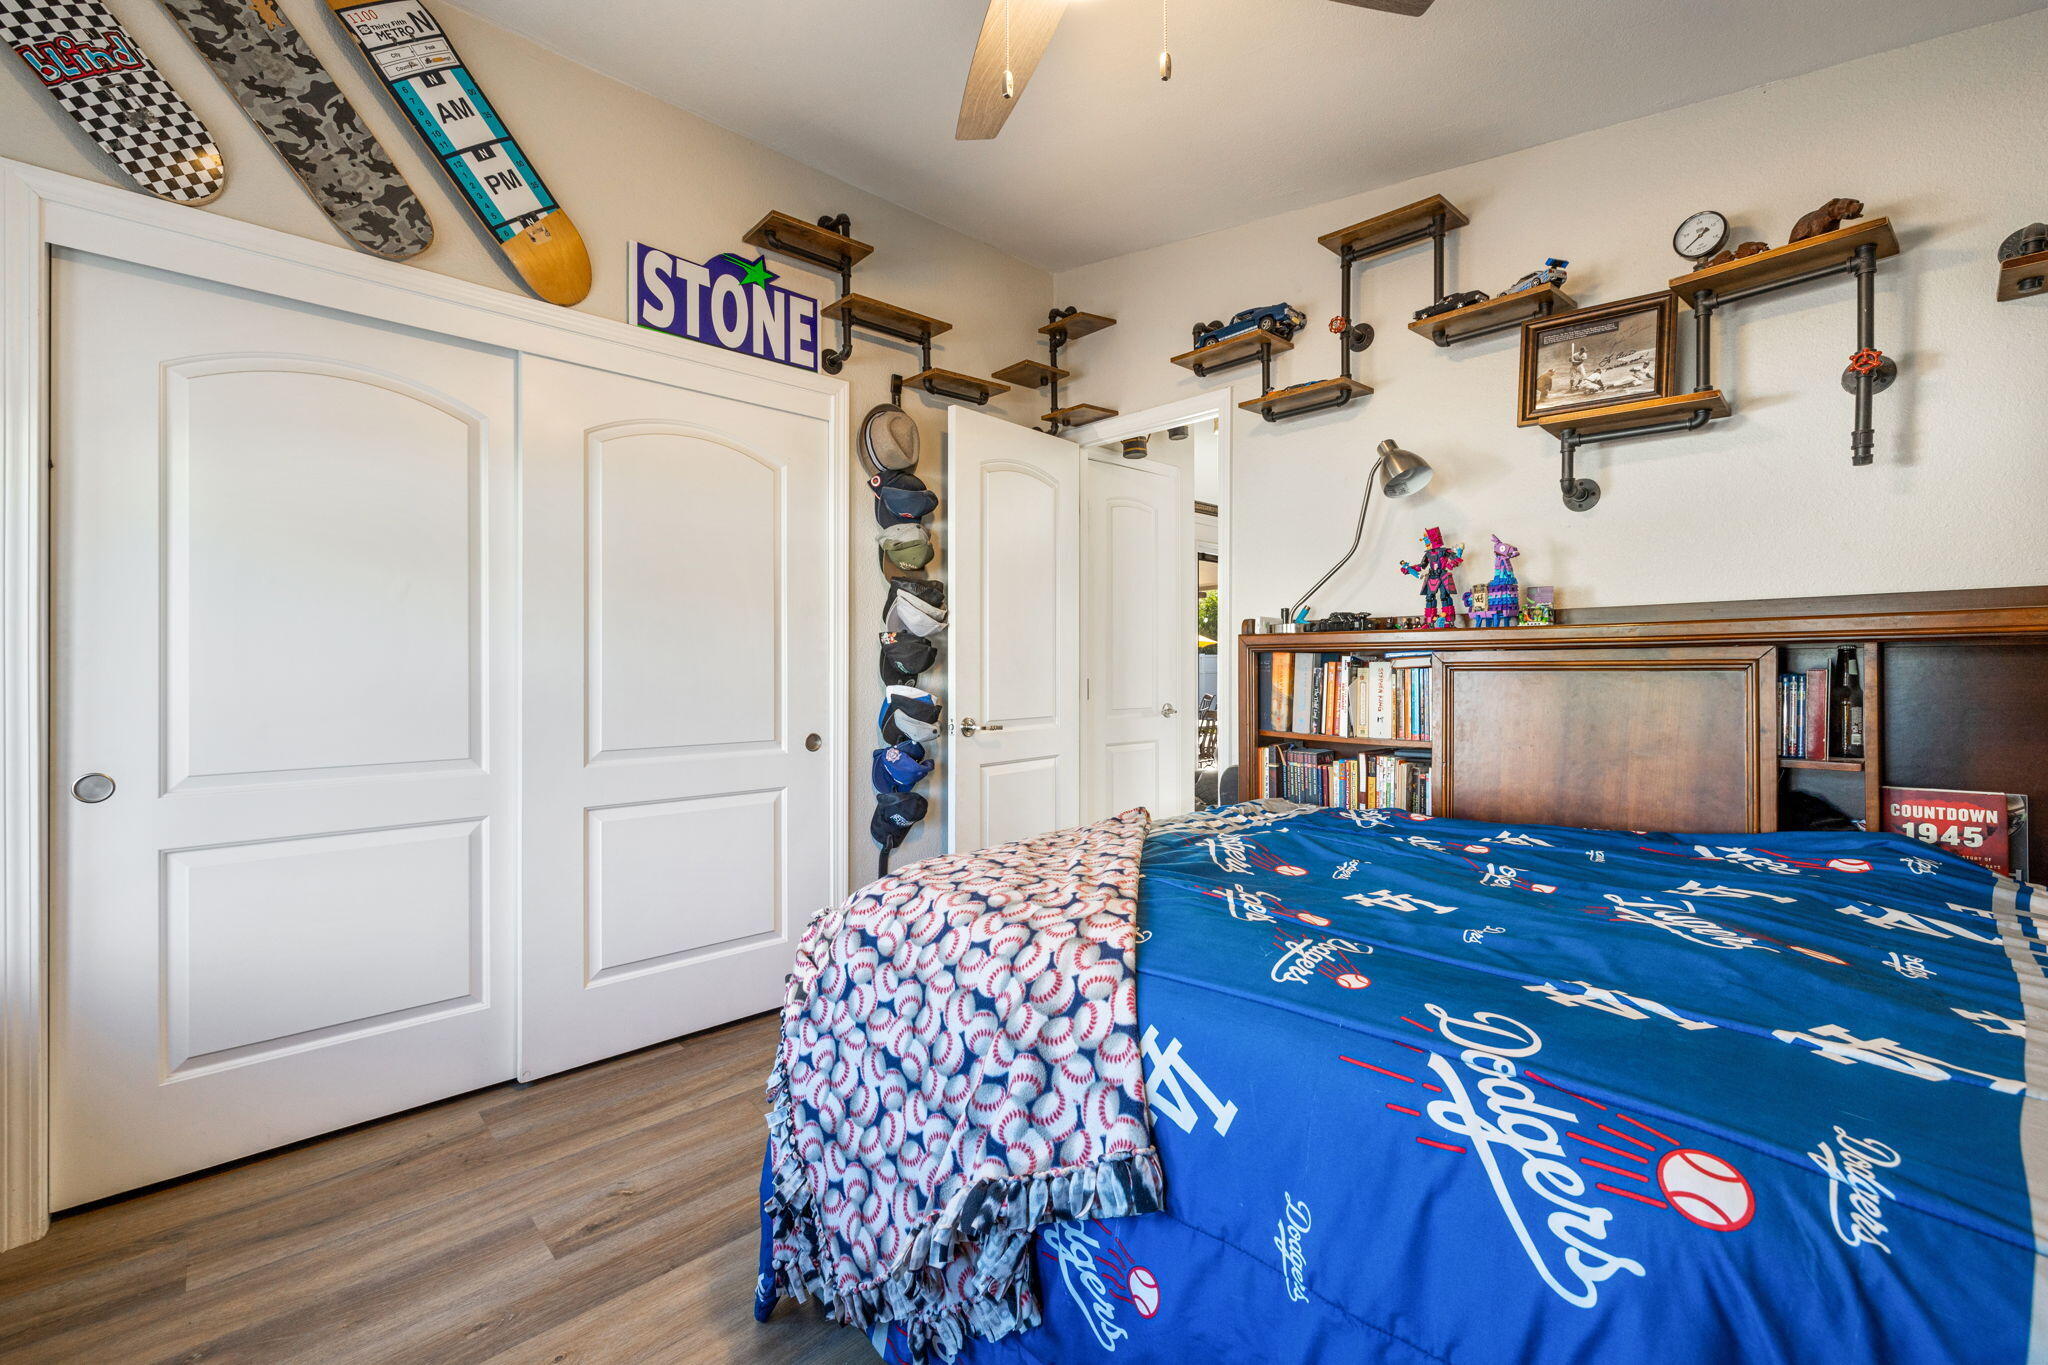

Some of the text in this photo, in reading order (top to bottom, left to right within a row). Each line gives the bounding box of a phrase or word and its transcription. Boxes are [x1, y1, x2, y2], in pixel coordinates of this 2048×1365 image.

[347, 9, 378, 24] 1100
[406, 10, 435, 33] N
[371, 19, 408, 31] Thirty Fifth
[375, 25, 415, 41] METRO
[426, 74, 439, 86] N
[401, 86, 409, 94] 6
[409, 97, 416, 105] 7
[417, 108, 425, 116] 8
[436, 97, 475, 124] AM
[425, 119, 432, 127] 9
[431, 131, 442, 139] 10
[439, 141, 449, 149] 11
[478, 149, 490, 159] N
[453, 160, 464, 169] 12
[483, 169, 523, 195] PM
[491, 212, 498, 220] 5
[642, 249, 814, 368] STONE
[1377, 668, 1385, 712] STEPHEN KING
[1890, 803, 1998, 824] COUNTDOWN
[1902, 822, 1984, 848] 1945
[1271, 938, 1374, 985] Dodgers
[1424, 1003, 1646, 1309] Dodgers
[1807, 1125, 1902, 1255] Dodgers
[1273, 1191, 1313, 1304] Dodgers
